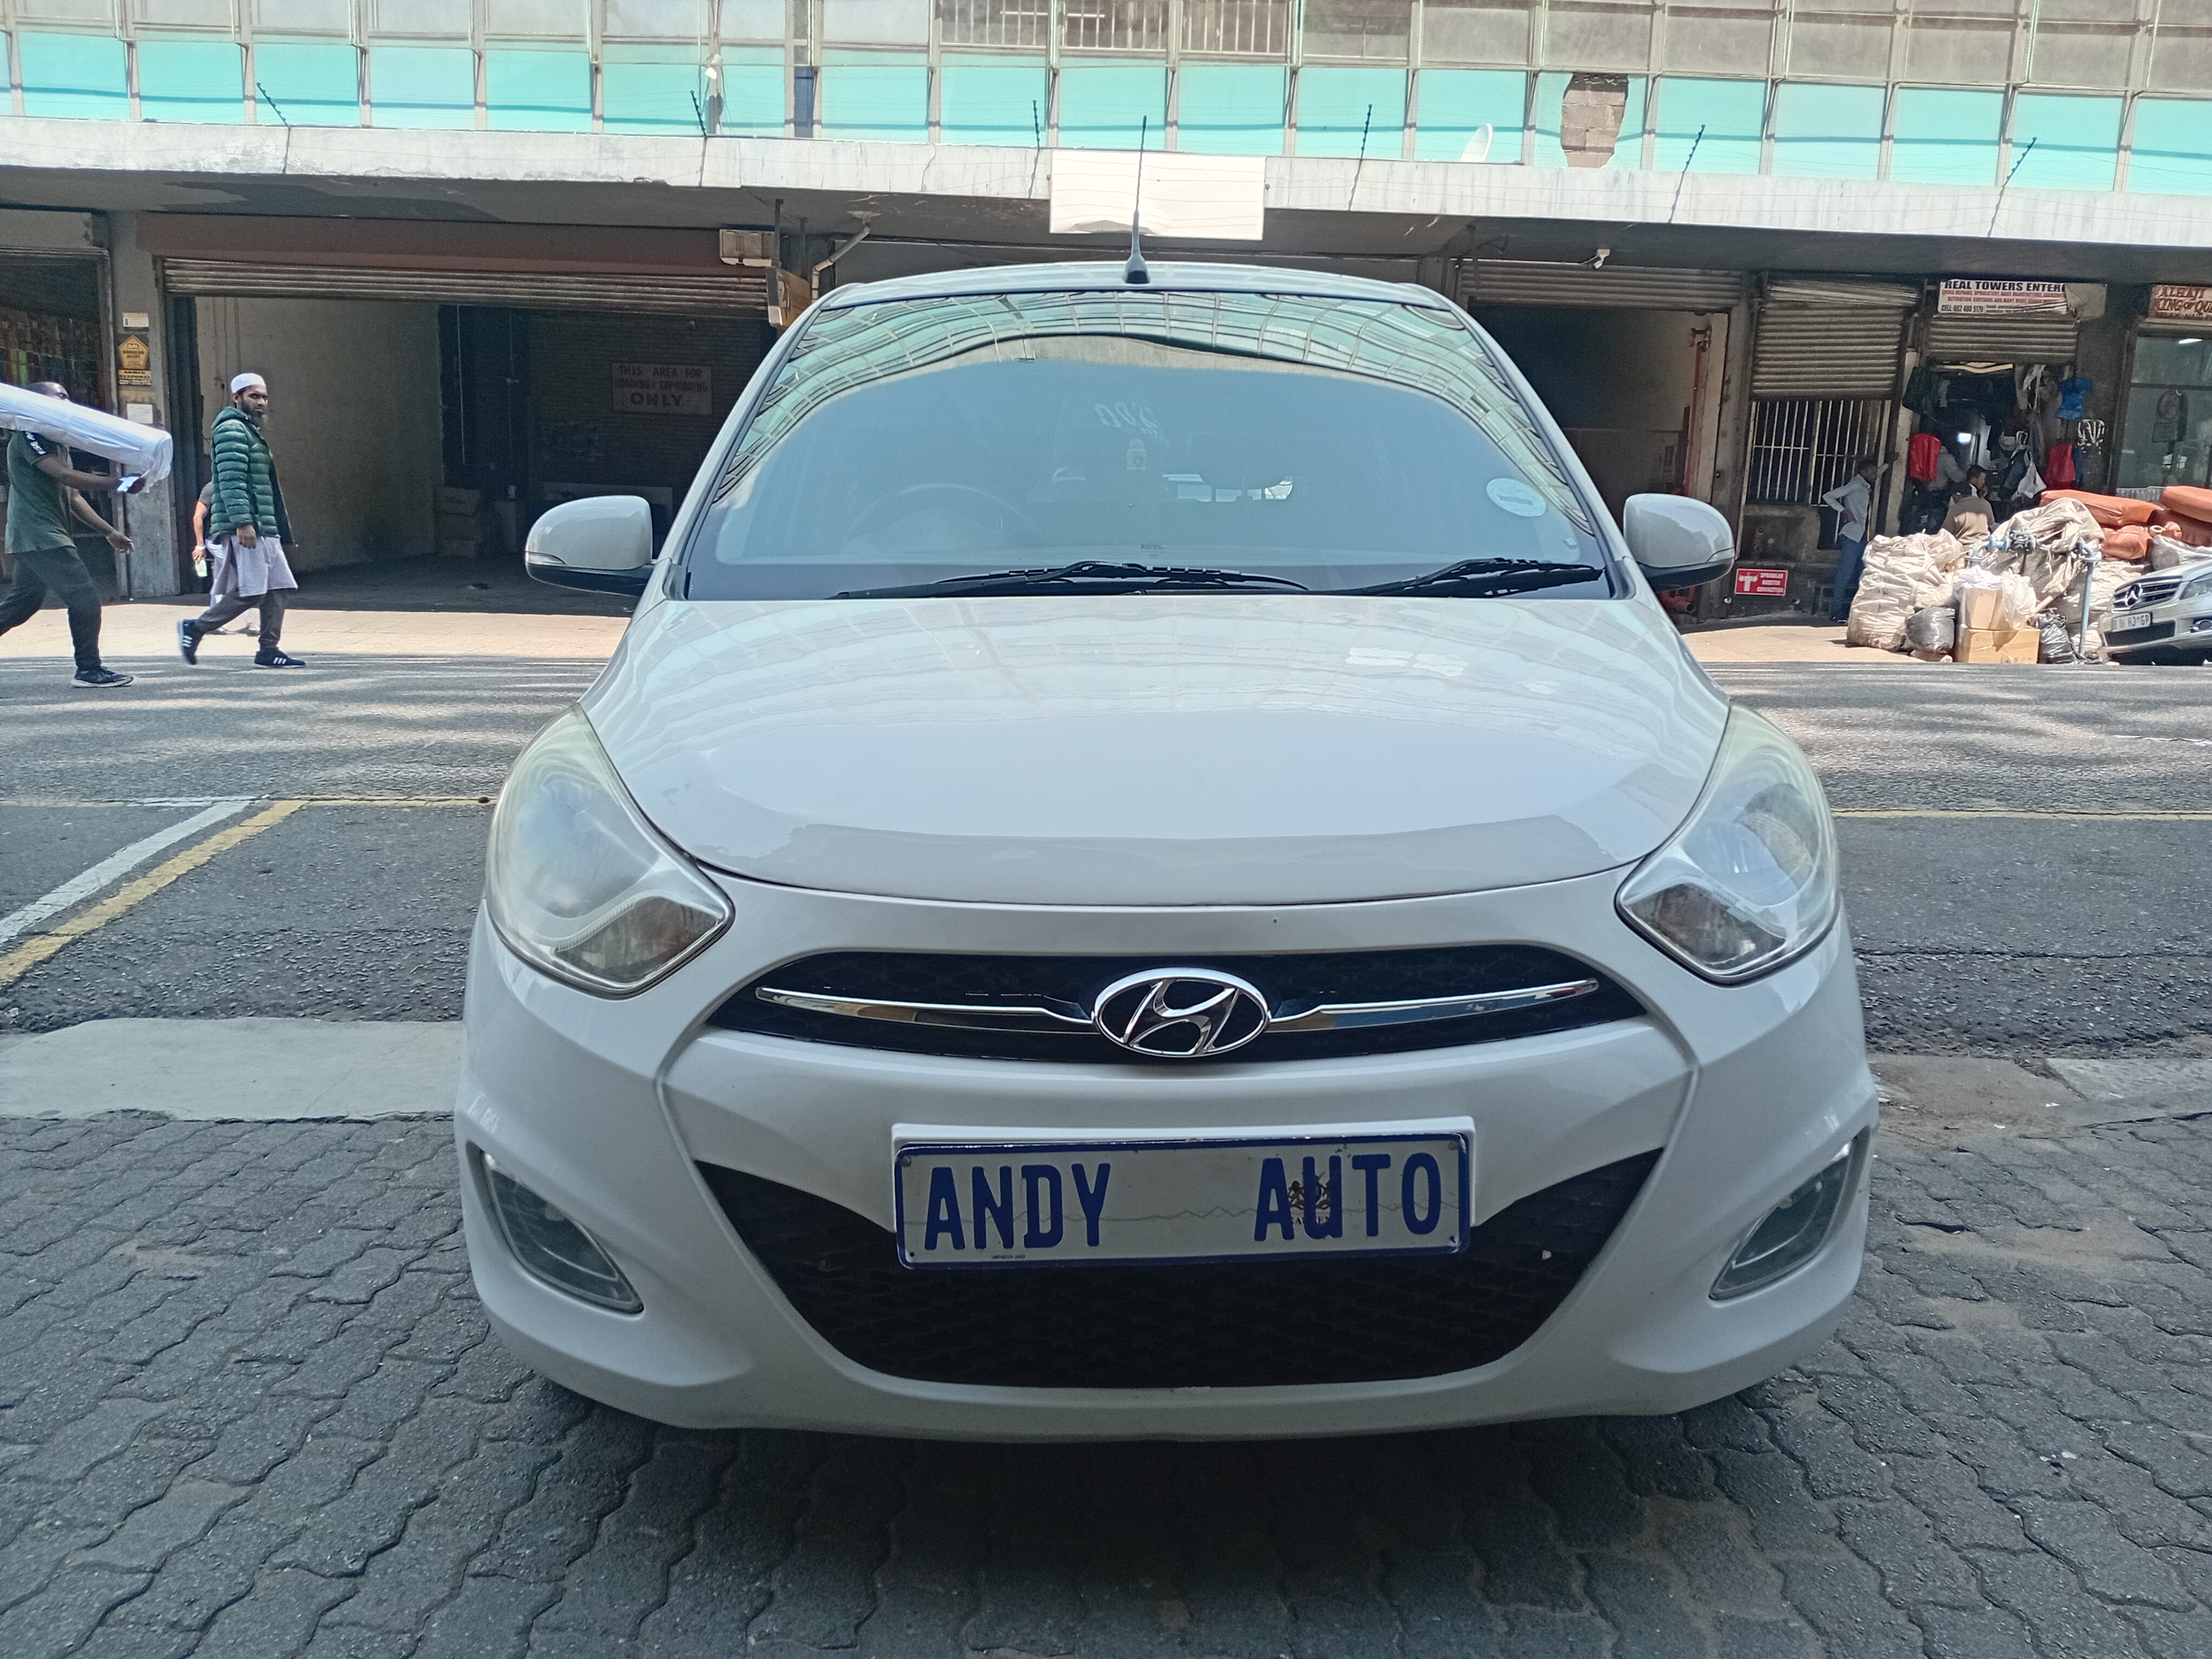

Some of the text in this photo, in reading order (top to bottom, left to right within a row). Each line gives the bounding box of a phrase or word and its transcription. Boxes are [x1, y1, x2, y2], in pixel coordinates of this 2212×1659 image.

[1945, 281, 1972, 290] REAL
[1976, 281, 2023, 291] TOWERS
[619, 365, 703, 378] THIS AREA FOR
[630, 392, 683, 407] ONLY
[924, 1152, 1442, 1250] ANDY AUTO
